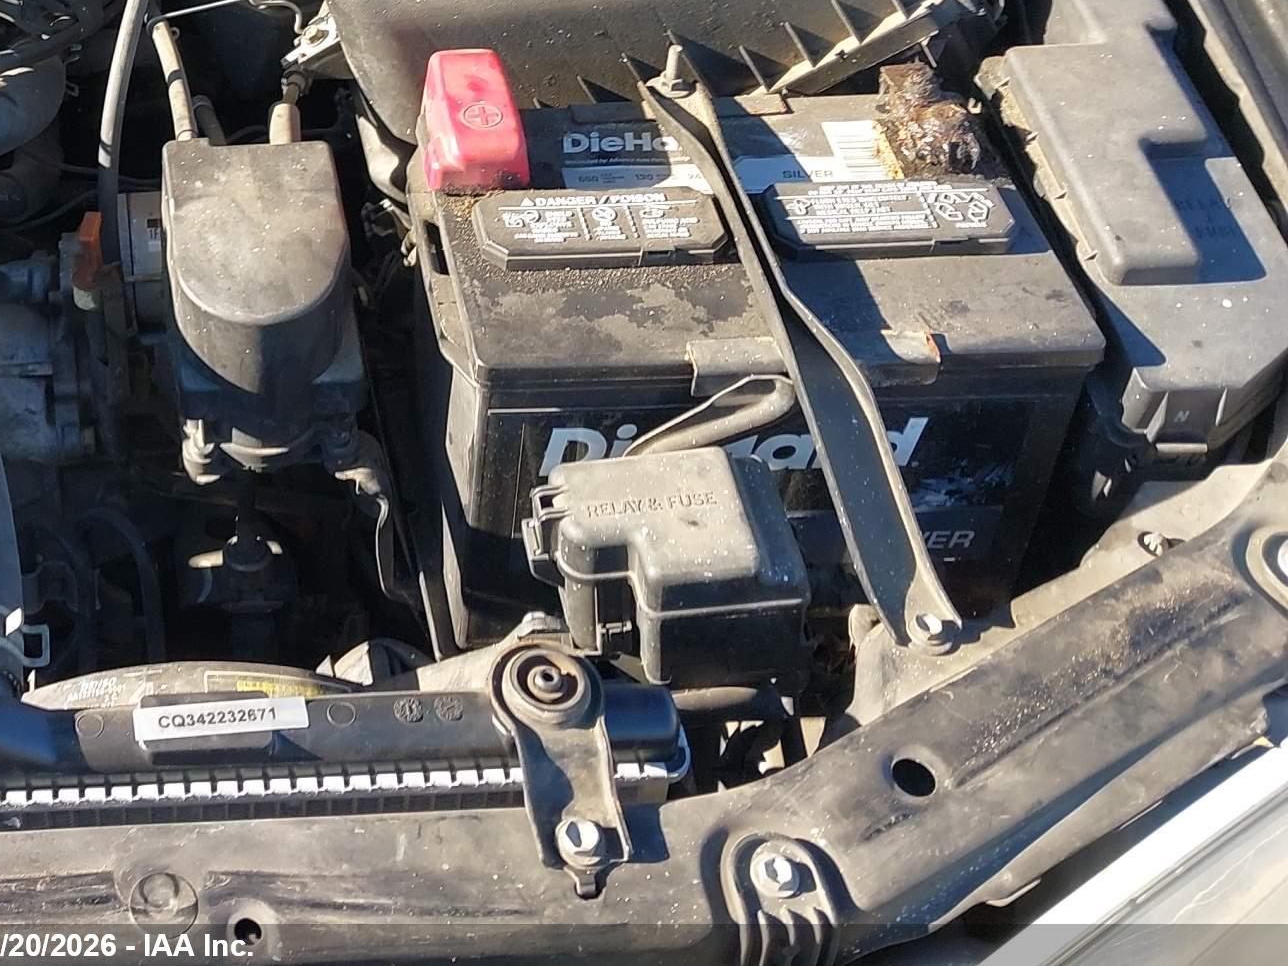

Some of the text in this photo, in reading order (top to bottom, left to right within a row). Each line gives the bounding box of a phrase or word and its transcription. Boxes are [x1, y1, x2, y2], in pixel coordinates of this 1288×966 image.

[536, 195, 597, 206] DANGER
[610, 192, 666, 205] POISON
[586, 500, 642, 518] RELAY
[668, 491, 718, 509] FUSE
